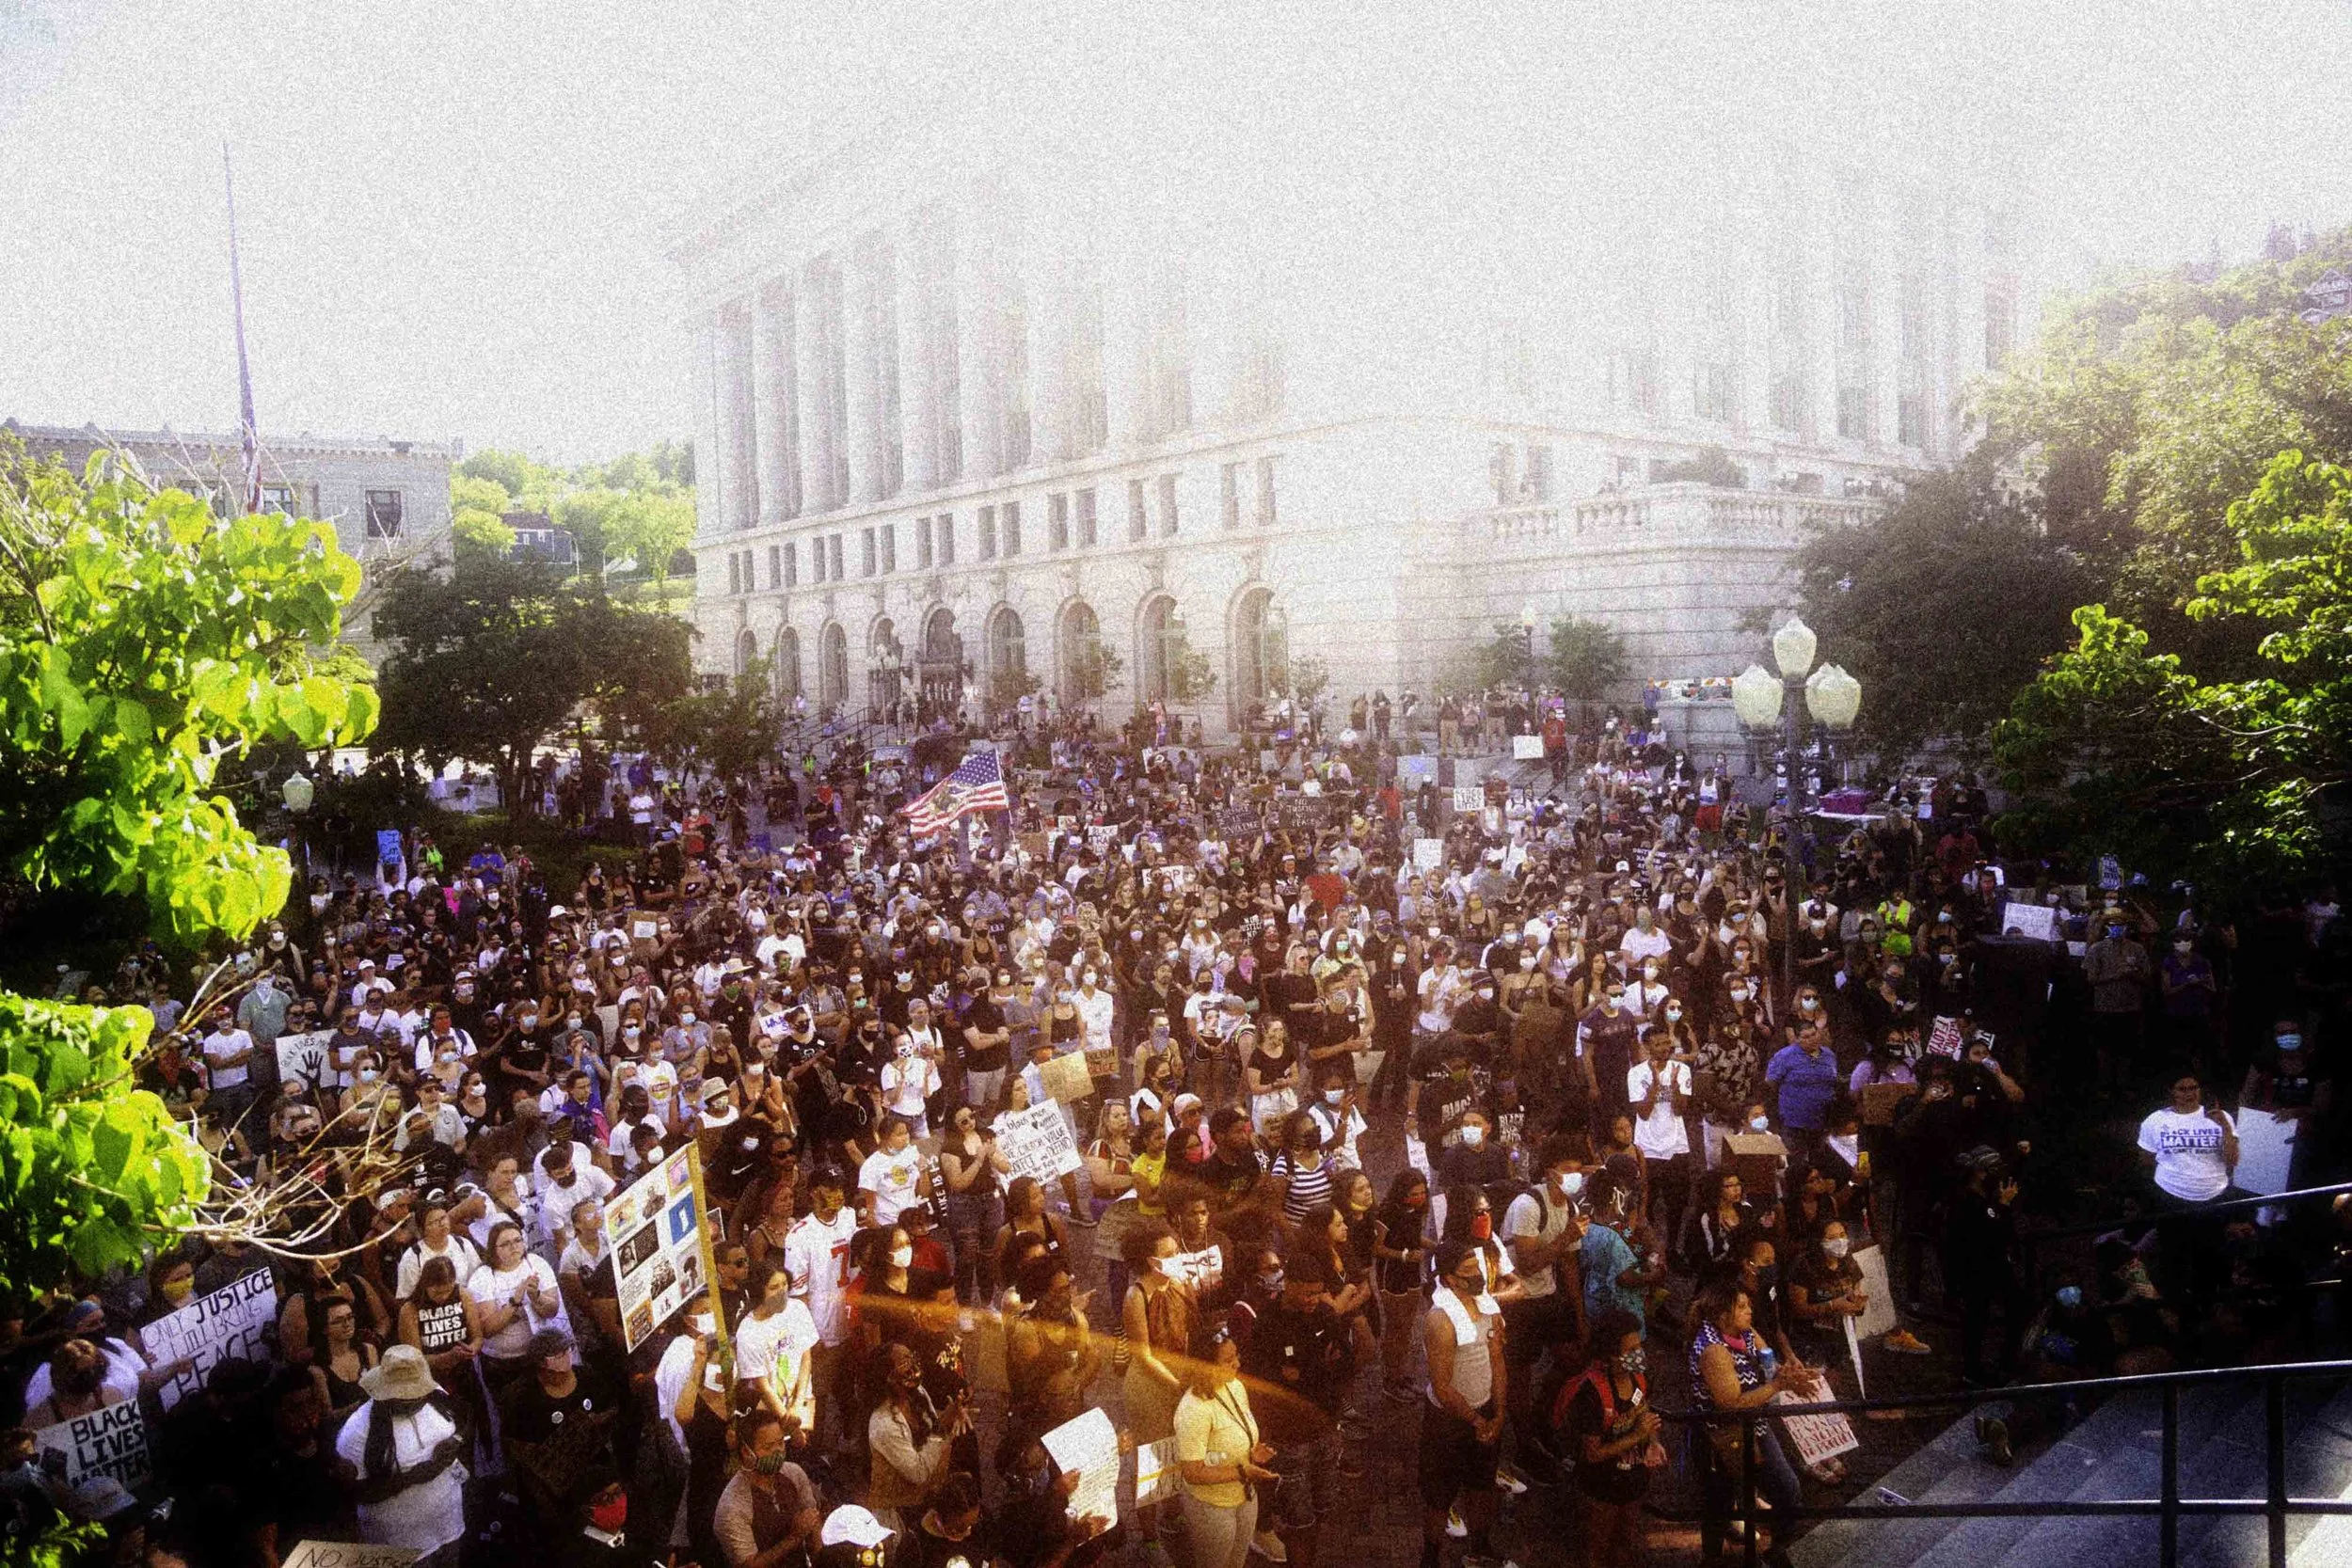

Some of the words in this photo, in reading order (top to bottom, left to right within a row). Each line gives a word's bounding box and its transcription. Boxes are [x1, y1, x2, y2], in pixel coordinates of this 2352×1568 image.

[1145, 868, 1182, 883] SOP
[1007, 1117, 1030, 1132] black
[2163, 1136, 2219, 1148] MATTER
[832, 1243, 851, 1290] 7
[142, 1314, 184, 1350] ONLY
[191, 1270, 274, 1324] JUSTICE
[419, 1302, 464, 1323] BLACK
[423, 1315, 463, 1335] LIVES
[71, 1402, 141, 1445] BLACK
[77, 1423, 145, 1470] LIVES
[295, 1547, 342, 1568] NO
